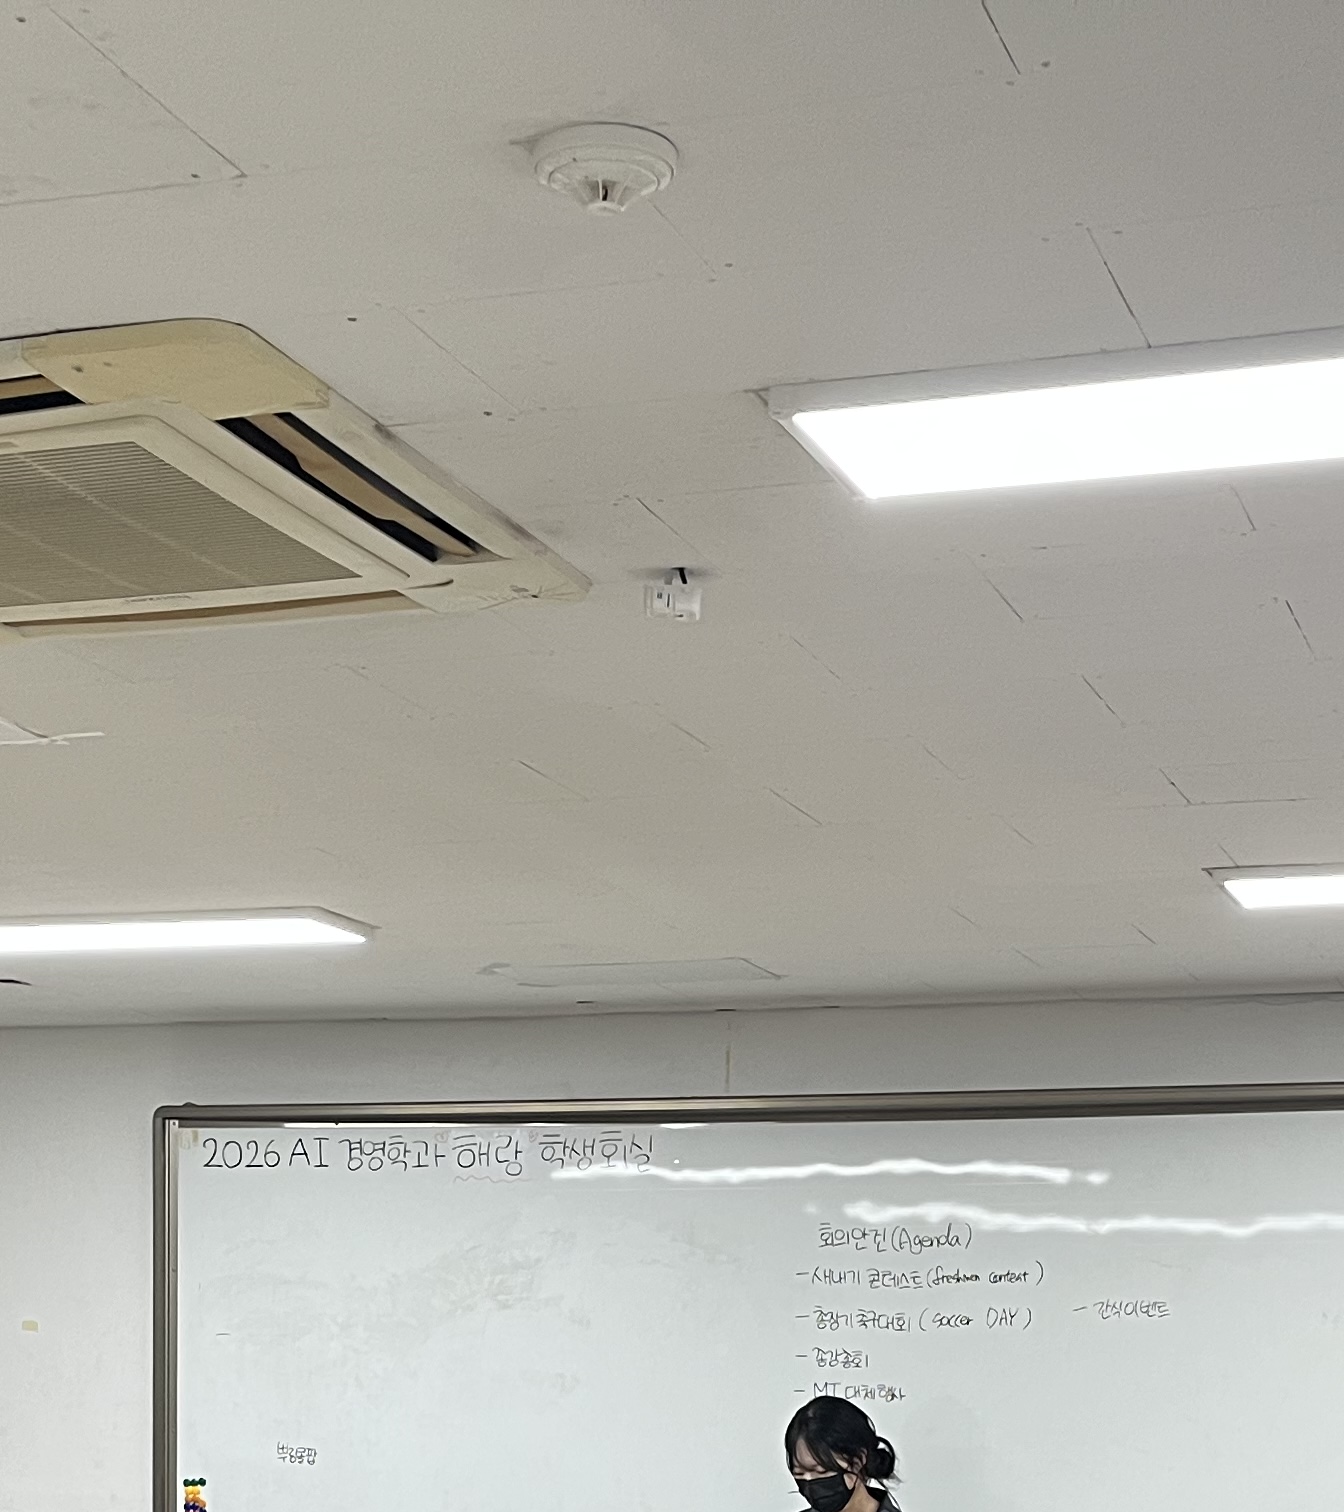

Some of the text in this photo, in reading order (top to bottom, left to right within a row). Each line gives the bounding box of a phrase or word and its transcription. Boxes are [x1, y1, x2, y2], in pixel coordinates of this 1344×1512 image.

[202, 1130, 654, 1177] 2026 AI 경영학과 해랑 학생회실
